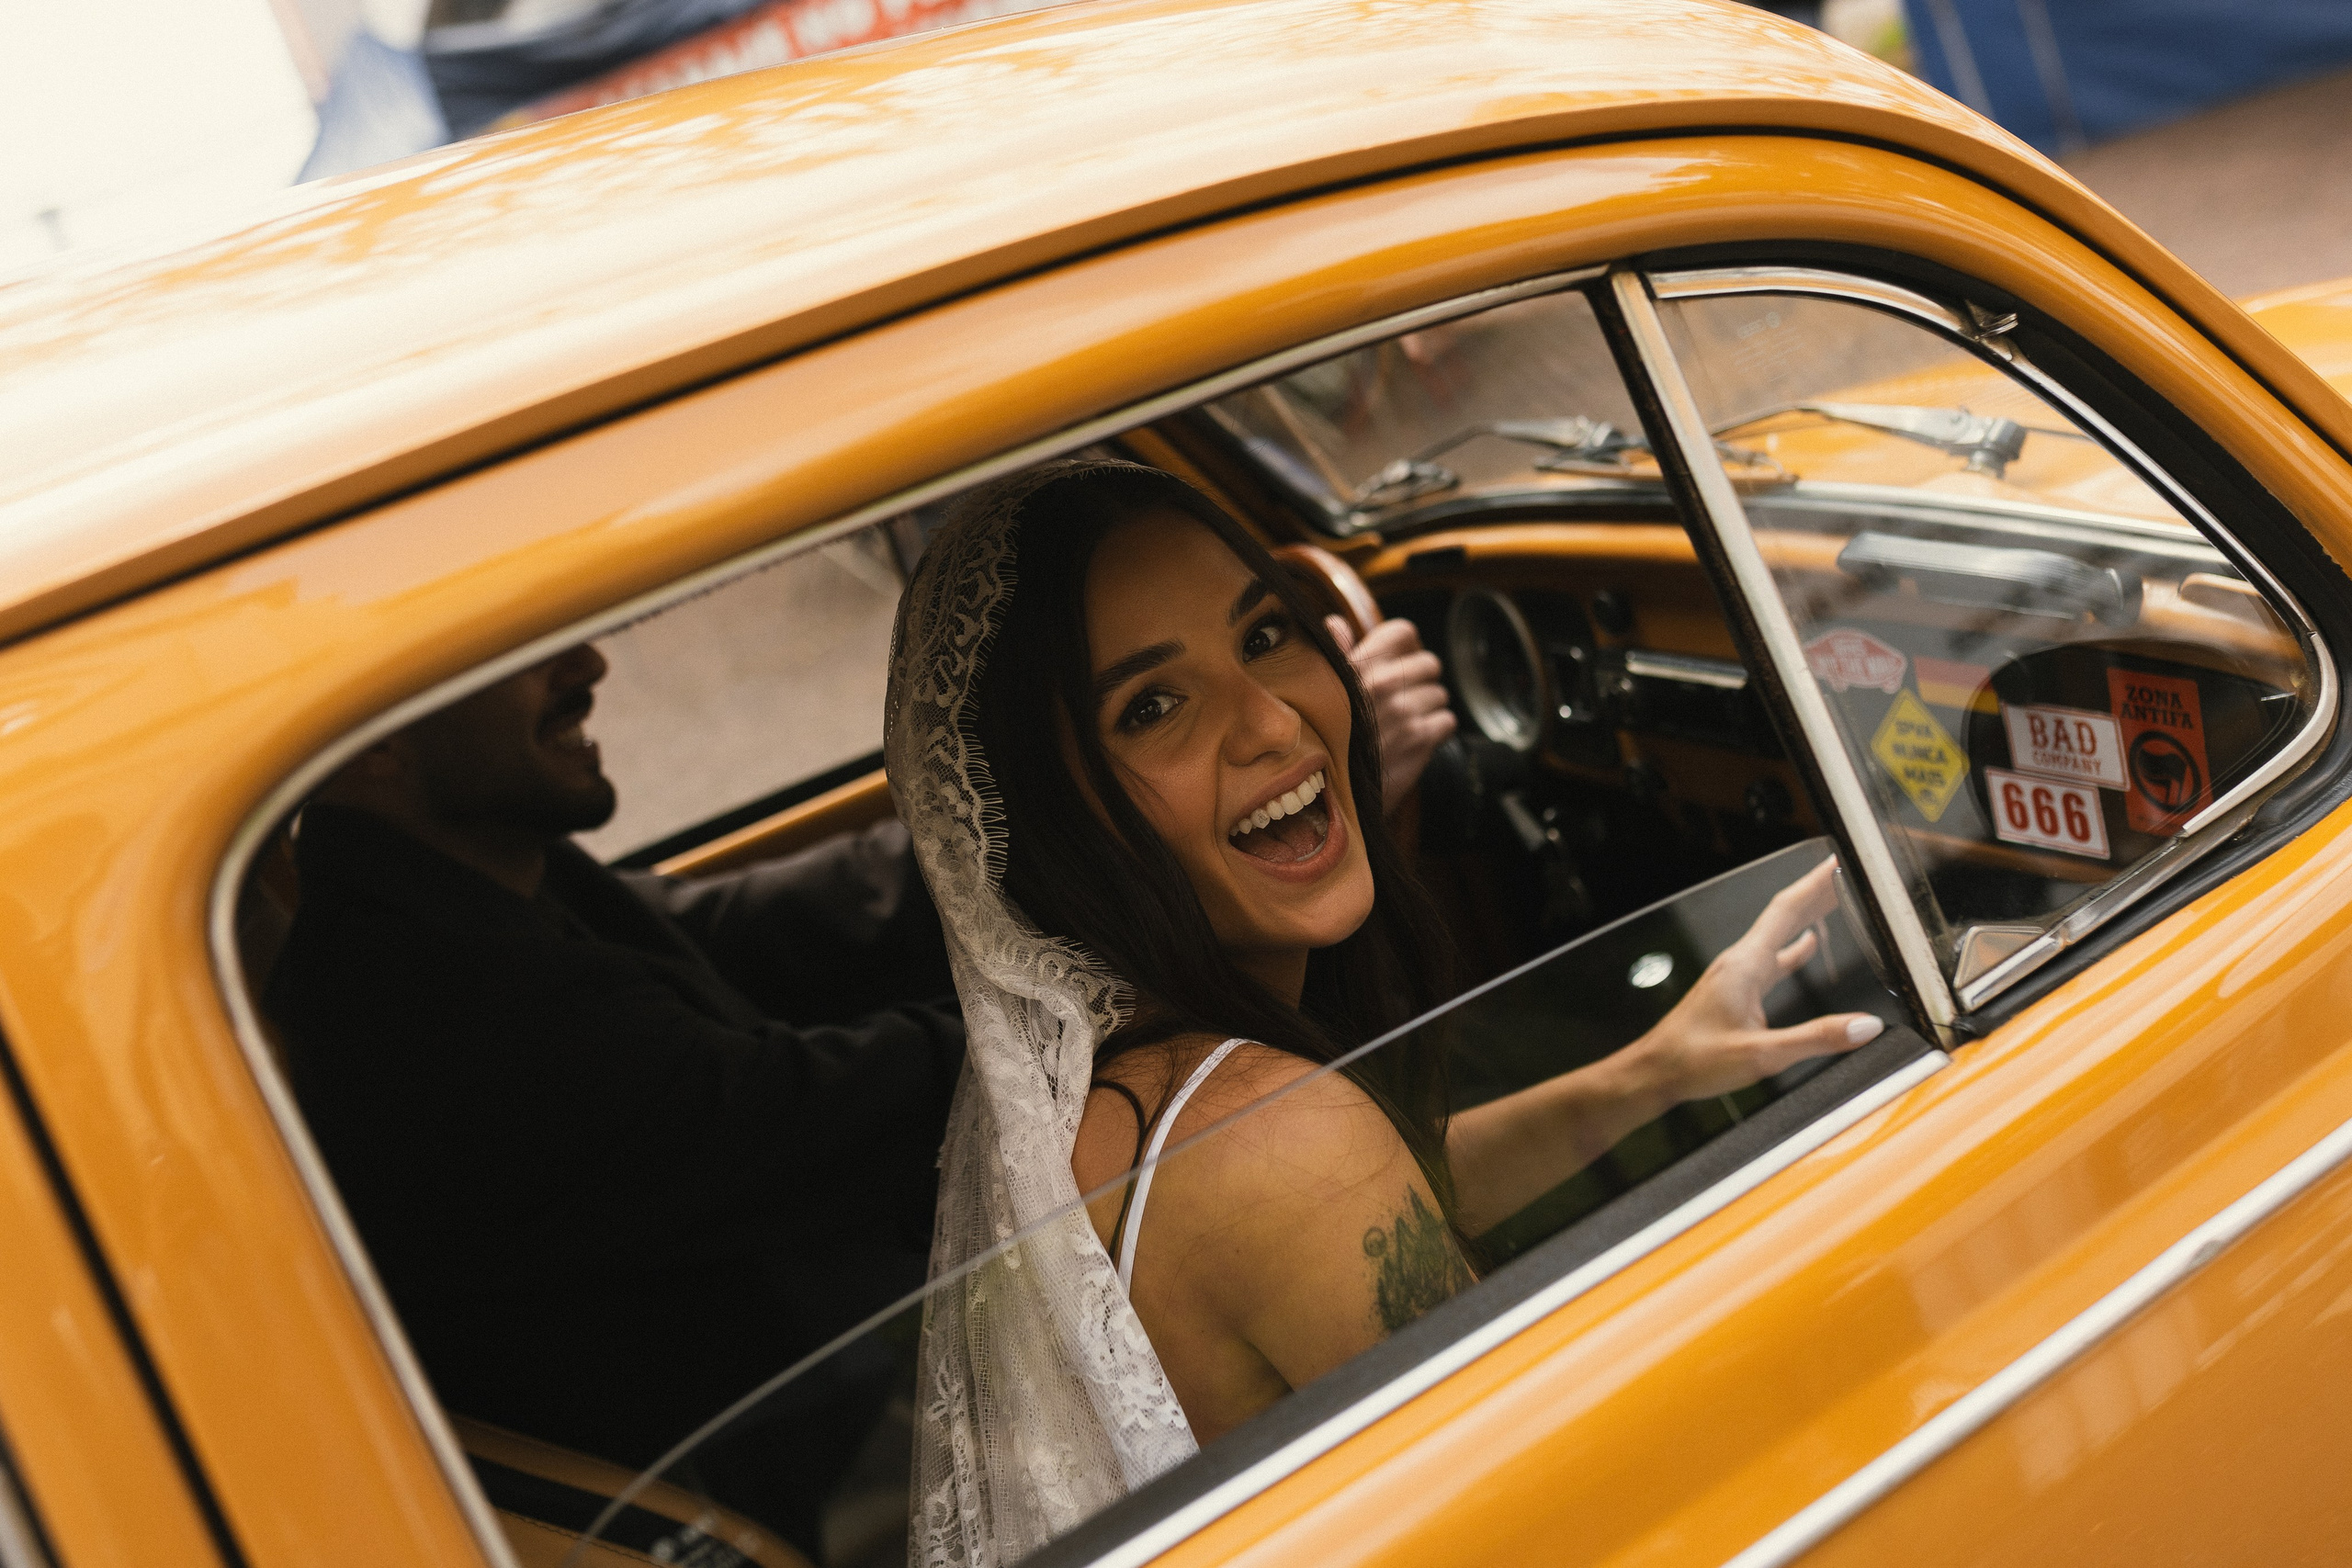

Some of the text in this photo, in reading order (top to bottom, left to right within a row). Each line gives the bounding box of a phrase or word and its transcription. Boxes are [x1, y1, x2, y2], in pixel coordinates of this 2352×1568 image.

[2125, 684, 2183, 709] ZONA
[2120, 703, 2194, 729] ANTIFA
[2026, 713, 2097, 757] BAD
[1892, 742, 1949, 765] NUNCA
[2032, 750, 2102, 775] COMPANY
[1903, 766, 1946, 788] MAIS
[2002, 782, 2092, 844] 666
